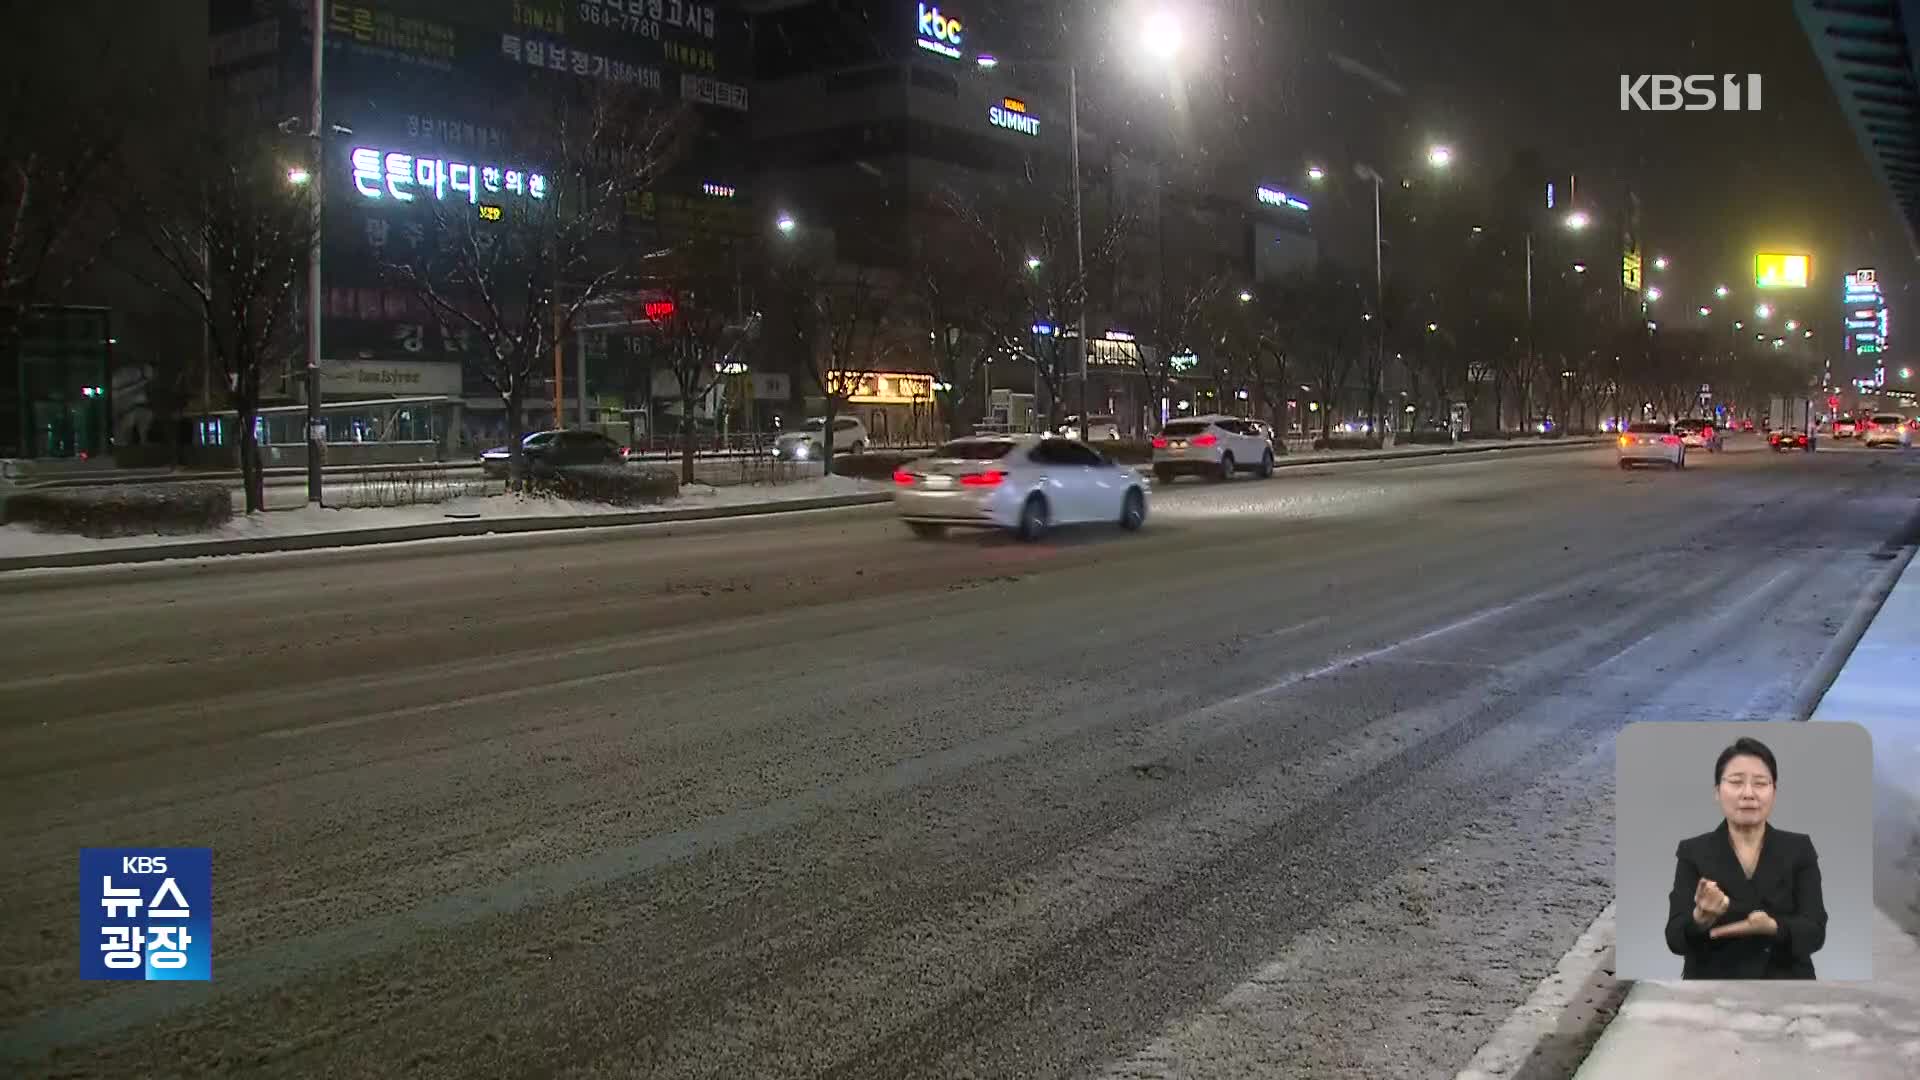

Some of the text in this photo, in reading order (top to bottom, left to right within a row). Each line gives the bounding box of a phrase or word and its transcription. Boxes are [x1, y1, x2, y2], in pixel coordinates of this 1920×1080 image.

[918, 2, 961, 45] kbc
[989, 105, 1040, 136] SUMMIT
[351, 147, 546, 204] 튼튼마디 한의원
